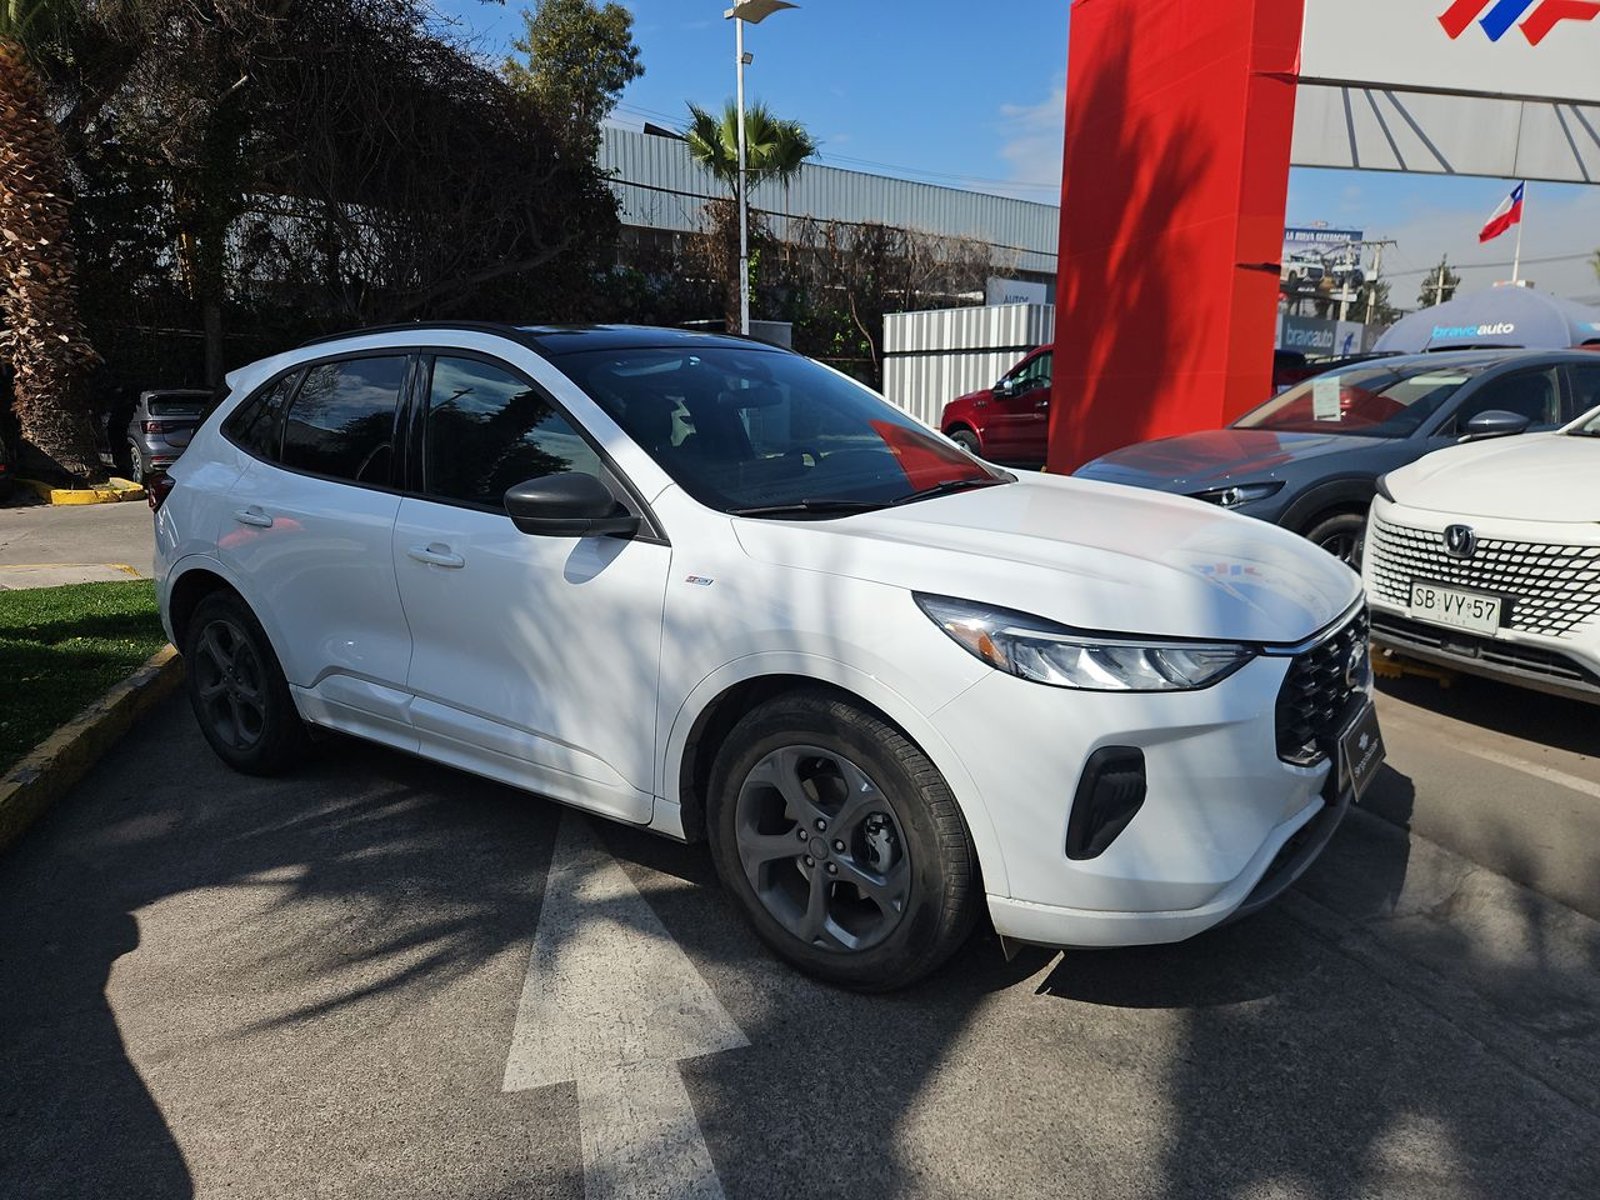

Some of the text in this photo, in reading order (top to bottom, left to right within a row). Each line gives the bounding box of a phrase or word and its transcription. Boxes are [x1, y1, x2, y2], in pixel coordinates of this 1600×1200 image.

[1432, 322, 1515, 338] bravoauto
[1414, 588, 1436, 609] SB
[1443, 593, 1466, 616] VY
[1473, 599, 1496, 621] 57
